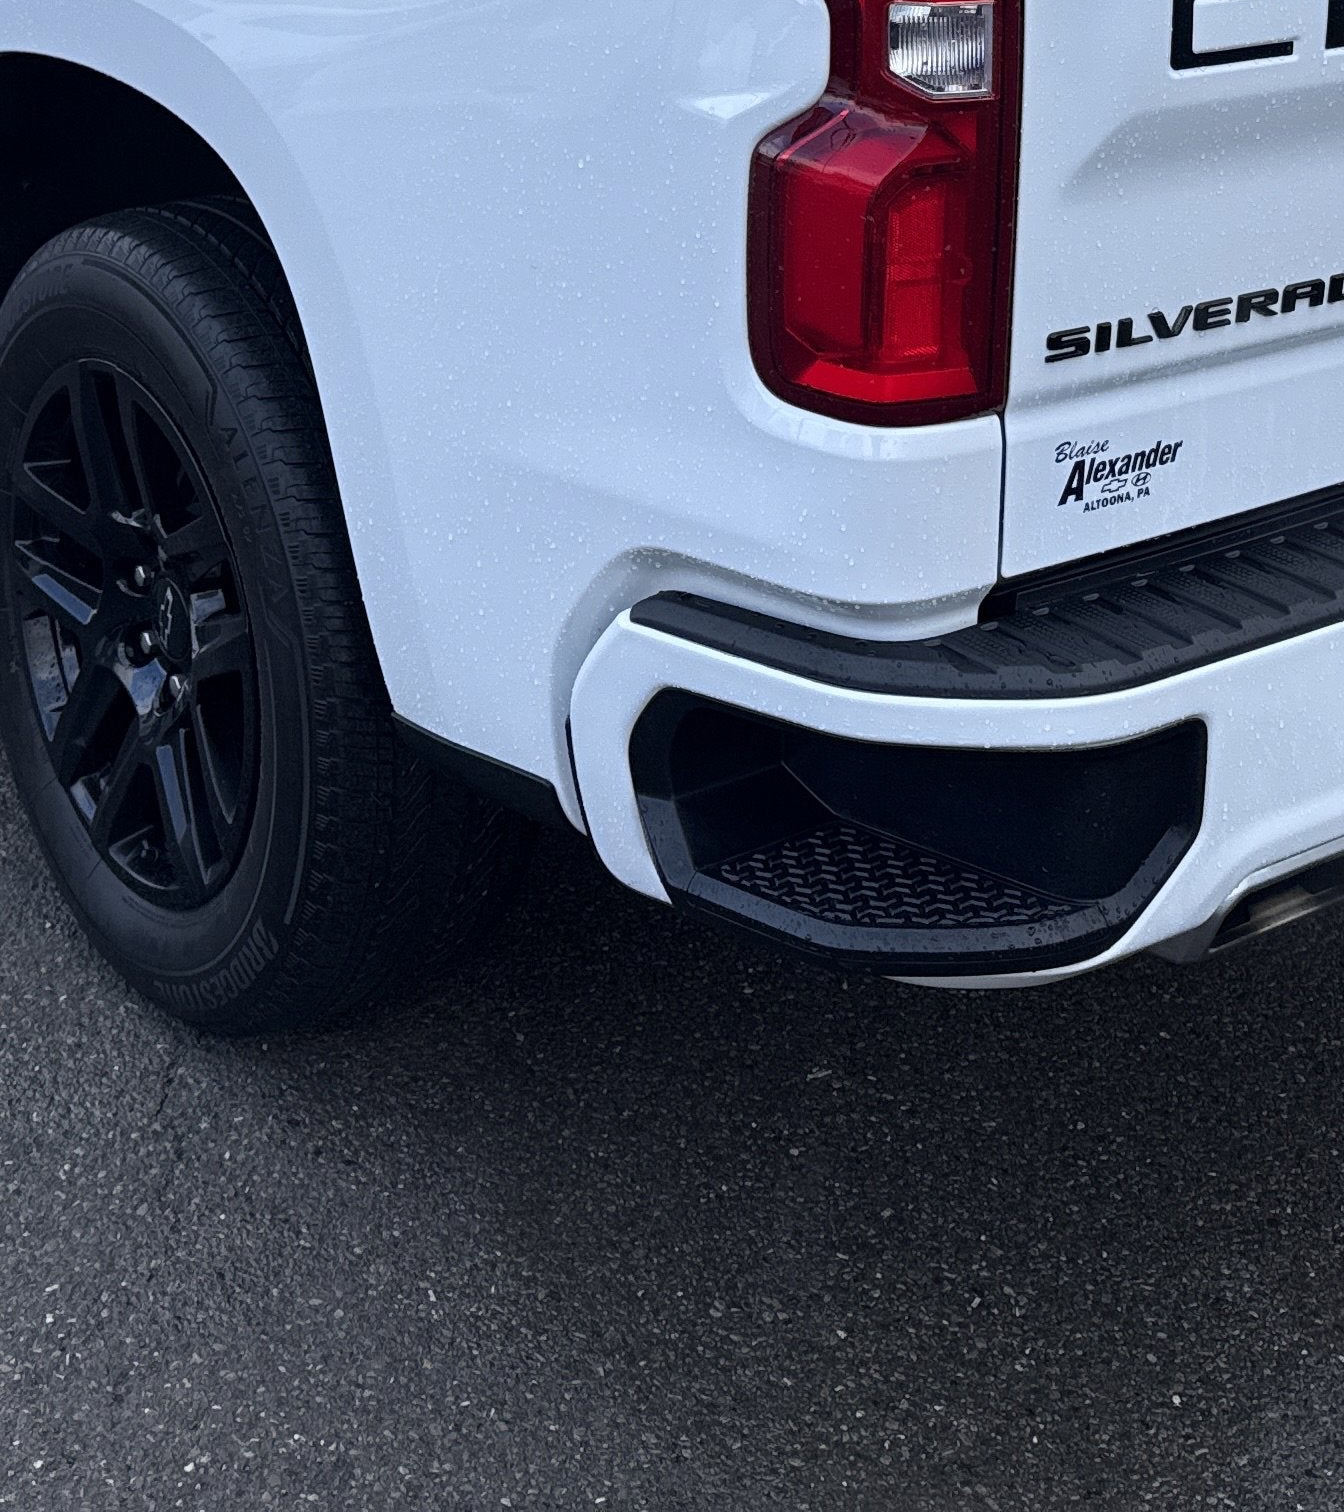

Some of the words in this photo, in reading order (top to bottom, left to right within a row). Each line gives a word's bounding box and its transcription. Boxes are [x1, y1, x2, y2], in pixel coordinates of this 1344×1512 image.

[1054, 439, 1110, 464] Blaise
[1057, 439, 1184, 507] Alexander
[1083, 490, 1135, 514] ALTOONA,
[1136, 486, 1151, 499] PA
